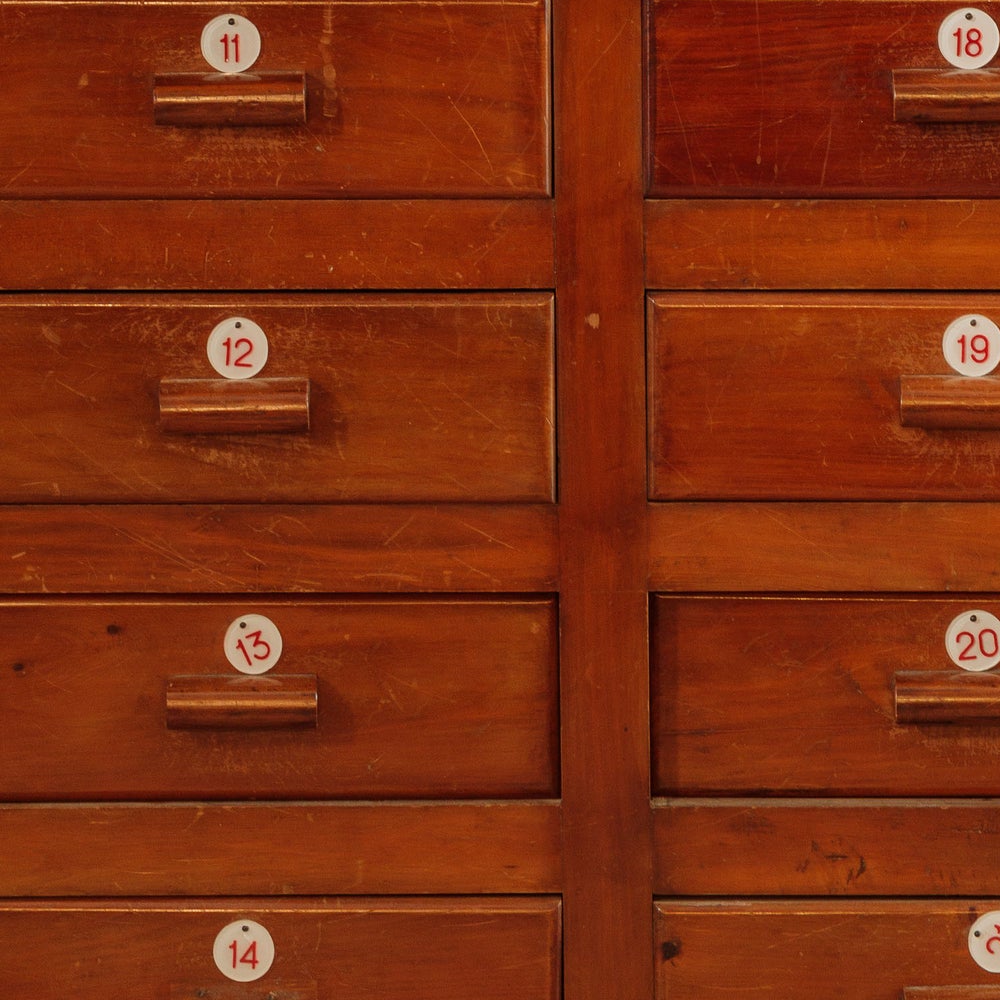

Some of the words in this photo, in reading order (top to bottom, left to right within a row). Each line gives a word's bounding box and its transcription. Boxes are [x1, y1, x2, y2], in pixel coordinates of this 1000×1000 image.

[220, 33, 241, 63] 11
[953, 27, 983, 58] 18
[223, 337, 254, 368] 12
[957, 334, 990, 365] 19
[236, 630, 271, 666] 13
[955, 628, 1000, 661] 20
[228, 939, 260, 969] 14
